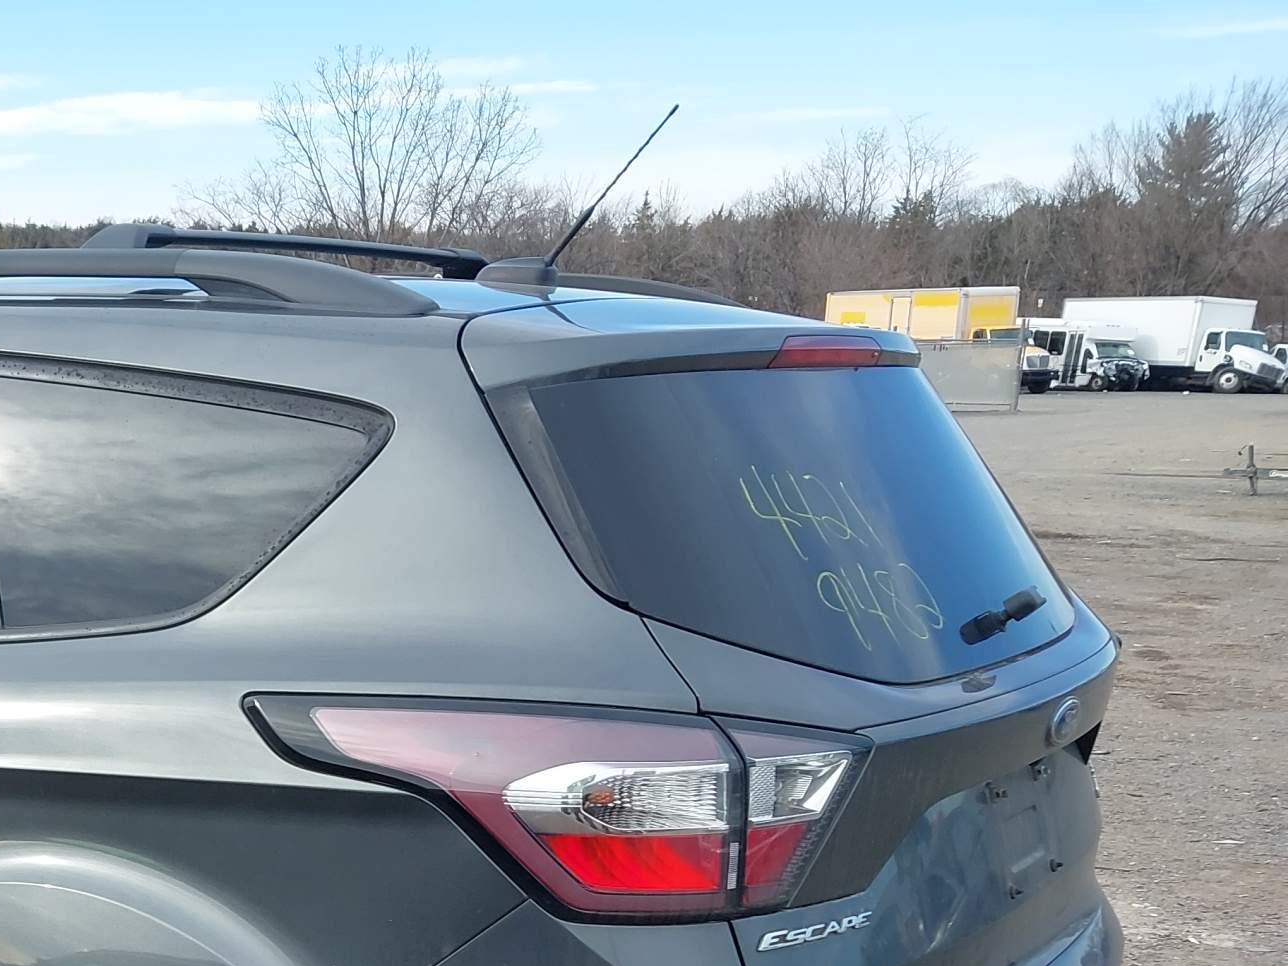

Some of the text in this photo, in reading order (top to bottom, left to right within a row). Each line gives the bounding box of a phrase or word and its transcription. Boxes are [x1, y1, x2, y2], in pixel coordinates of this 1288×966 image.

[740, 465, 883, 561] 4421
[816, 563, 944, 651] 9482
[758, 911, 873, 952] ESCAPE
